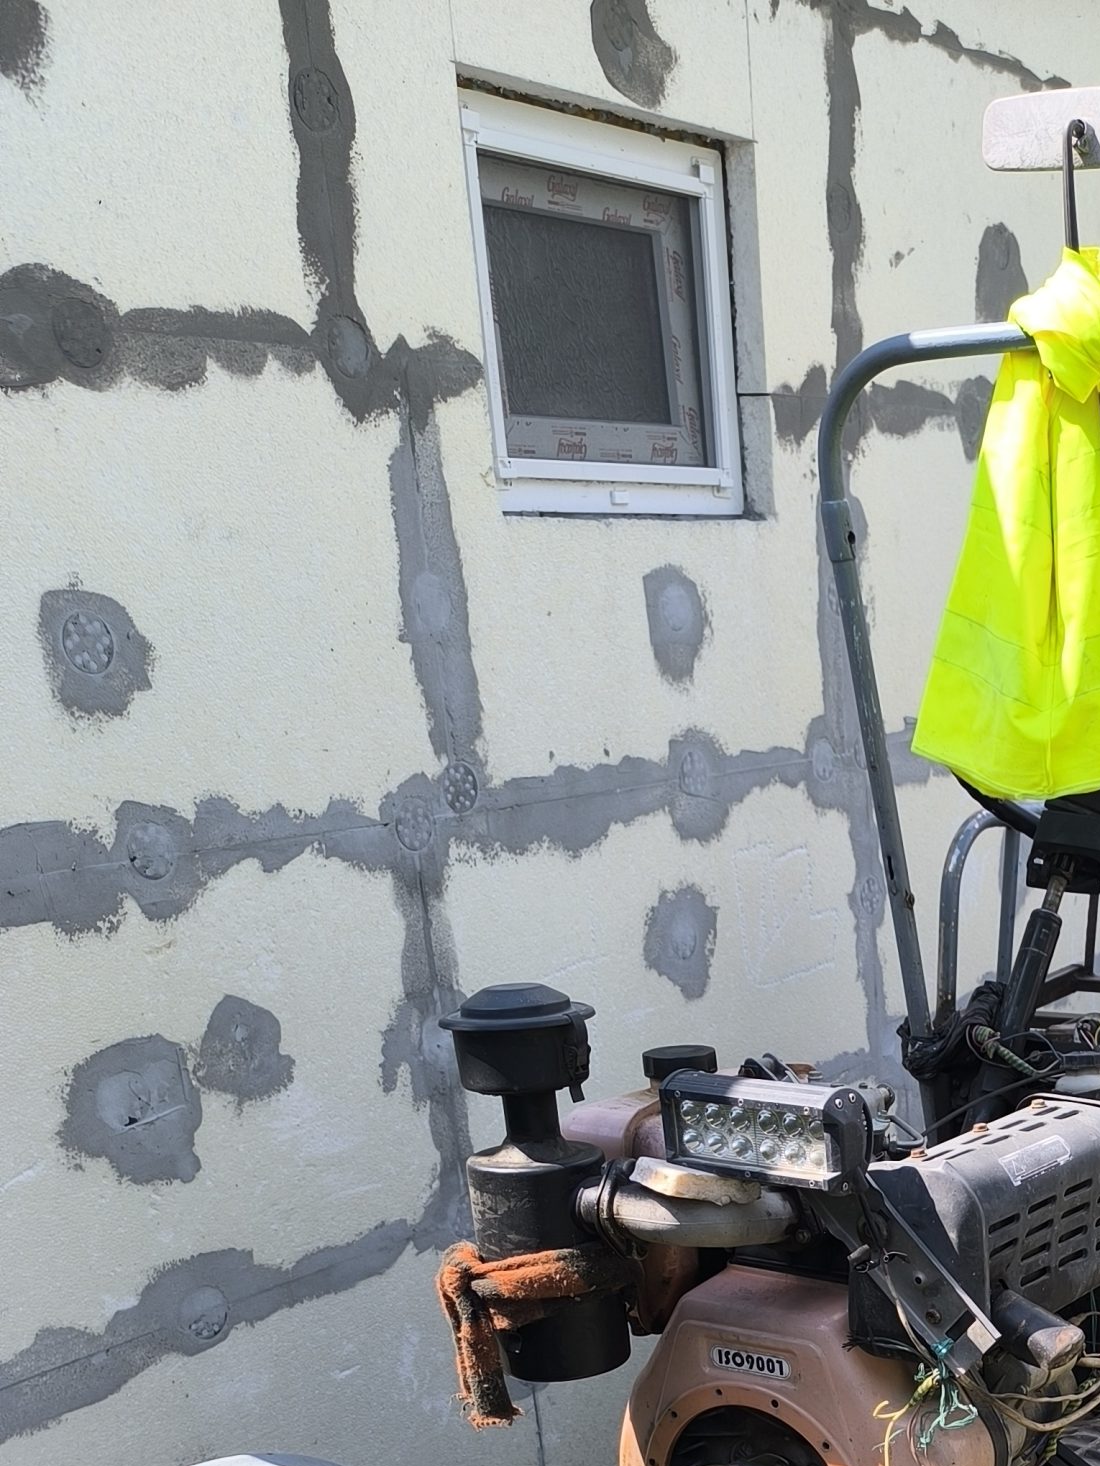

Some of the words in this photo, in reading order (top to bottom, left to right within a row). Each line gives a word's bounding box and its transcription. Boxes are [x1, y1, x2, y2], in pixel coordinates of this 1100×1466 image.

[547, 175, 578, 201] Galaxy
[672, 250, 685, 302] Galaxy
[716, 1349, 784, 1376] ISO9001
